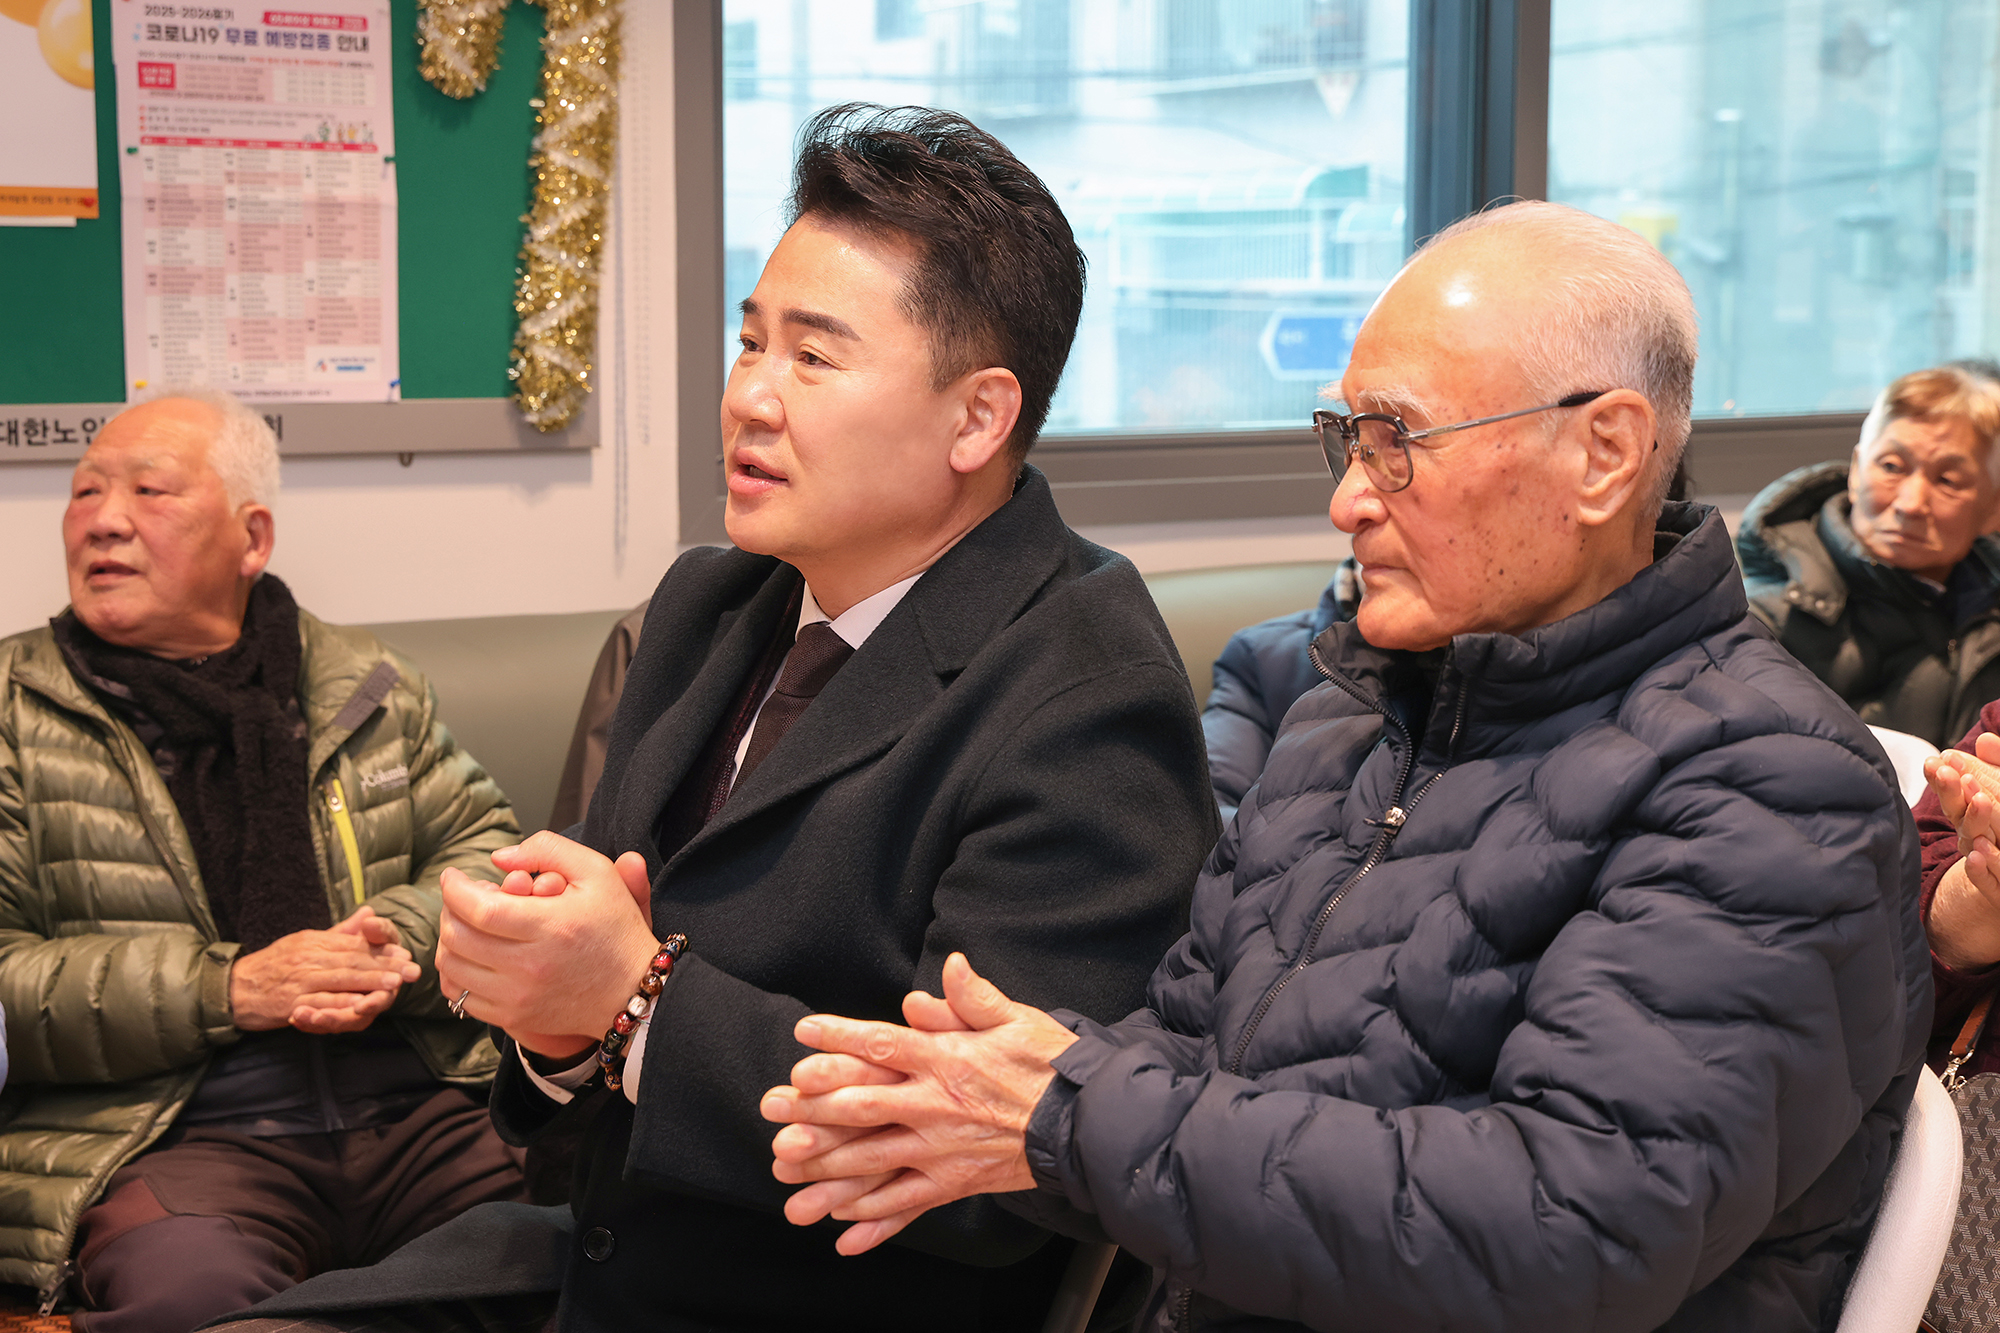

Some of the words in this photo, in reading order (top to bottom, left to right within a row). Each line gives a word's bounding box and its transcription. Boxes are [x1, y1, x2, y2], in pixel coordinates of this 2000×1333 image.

[146, 23, 219, 44] 코로나19
[226, 28, 258, 46] 무료
[265, 31, 330, 51] 예방접종
[337, 34, 369, 52] 안내
